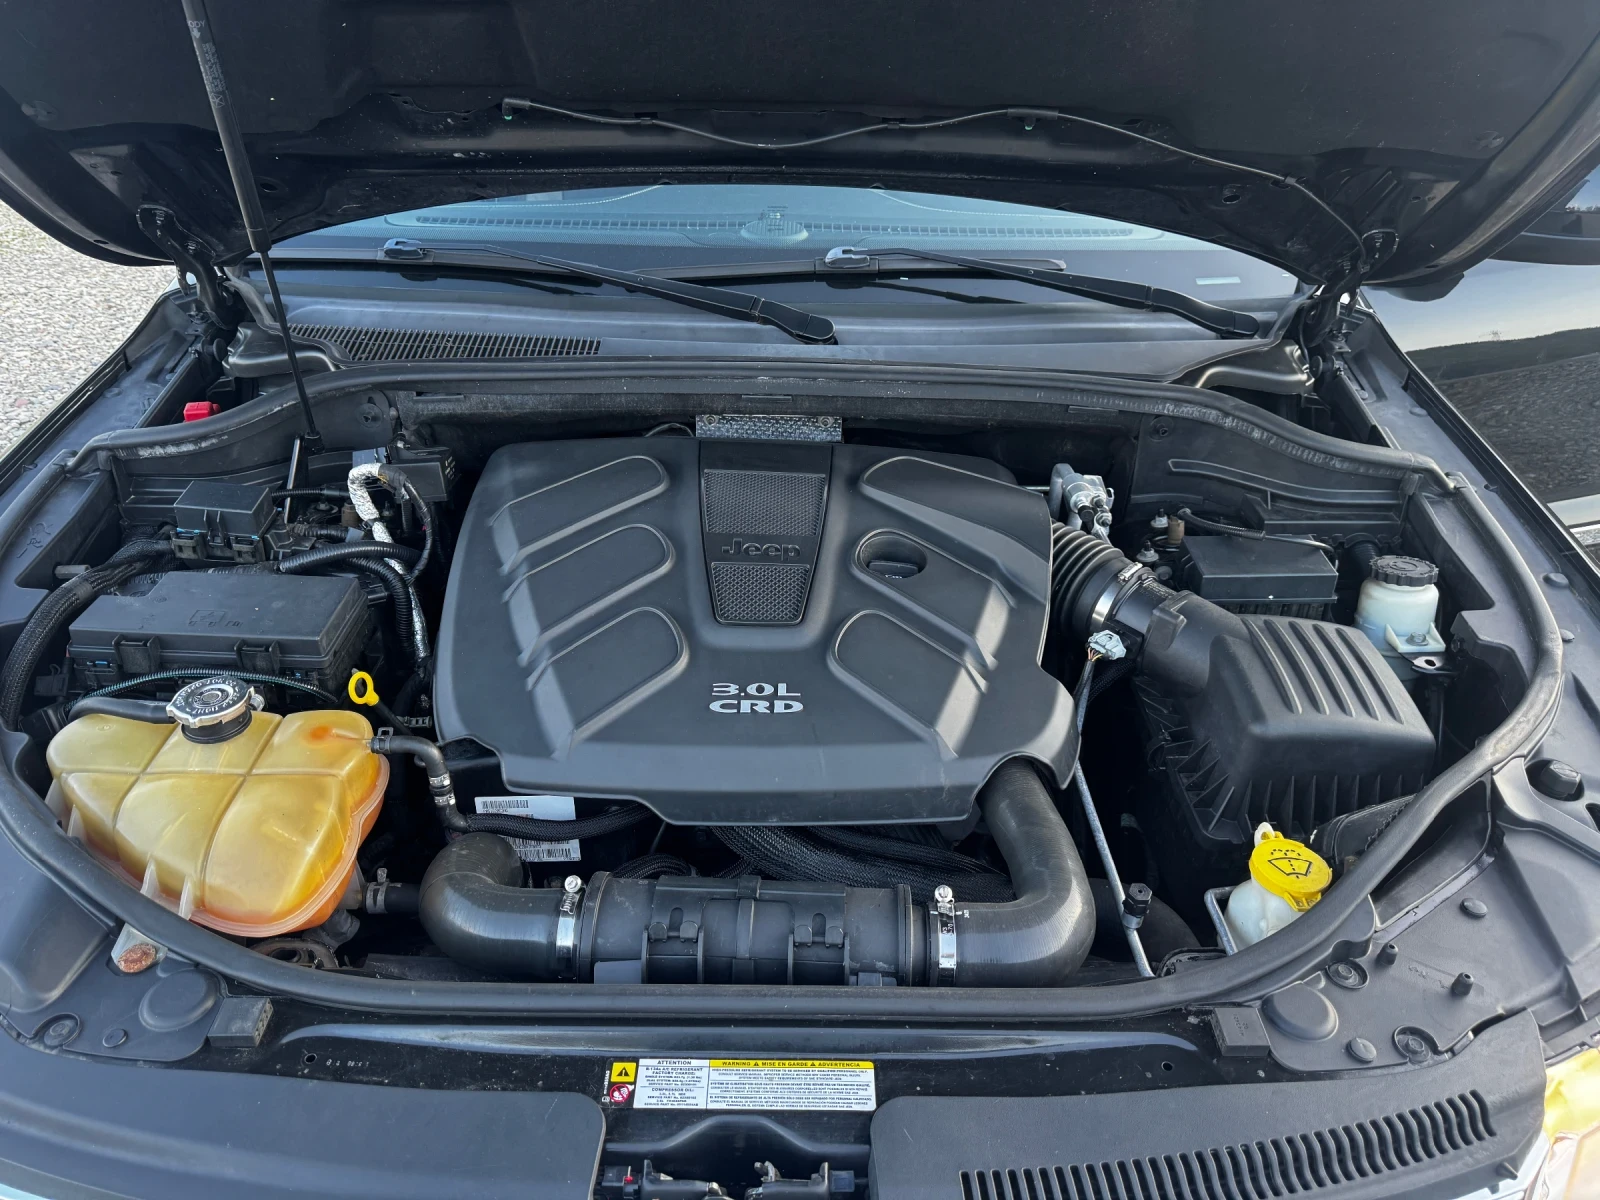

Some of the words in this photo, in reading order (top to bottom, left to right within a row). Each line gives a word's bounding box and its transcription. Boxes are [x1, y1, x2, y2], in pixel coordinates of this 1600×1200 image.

[721, 537, 801, 561] Jeep
[711, 682, 801, 696] 3.0L
[709, 699, 804, 713] CRD
